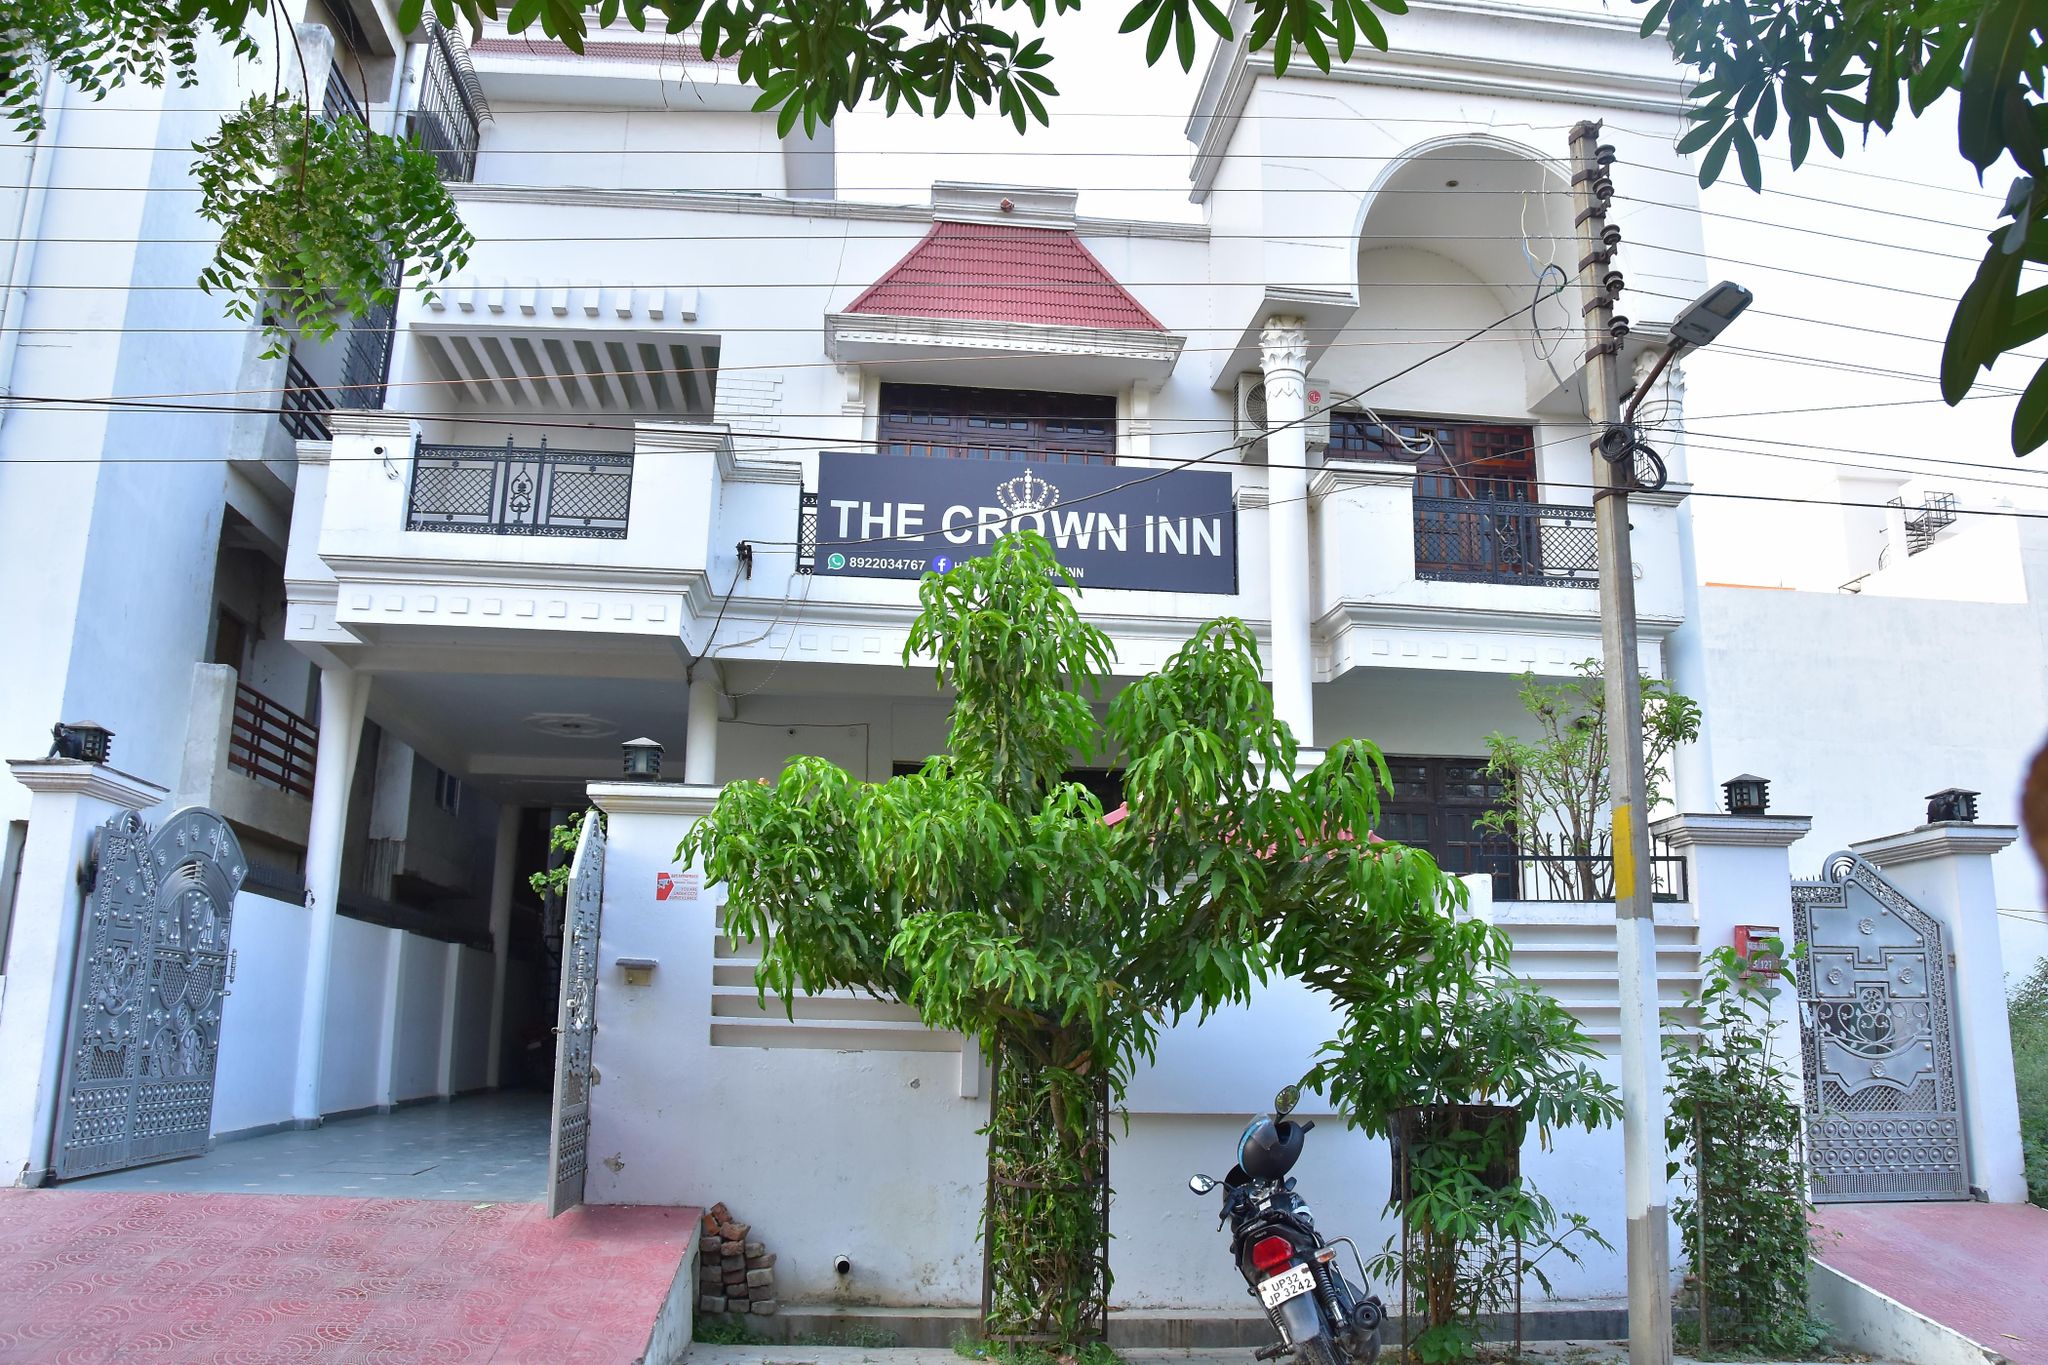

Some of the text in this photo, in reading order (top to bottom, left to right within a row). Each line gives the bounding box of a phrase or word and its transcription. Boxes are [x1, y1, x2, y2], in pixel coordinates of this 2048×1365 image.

[1308, 405, 1320, 413] LG
[830, 500, 1221, 556] THE CROWN INN
[849, 557, 926, 570] 8922034767
[1269, 1278, 1312, 1306] JP 3242
[1271, 1273, 1299, 1292] UP32
